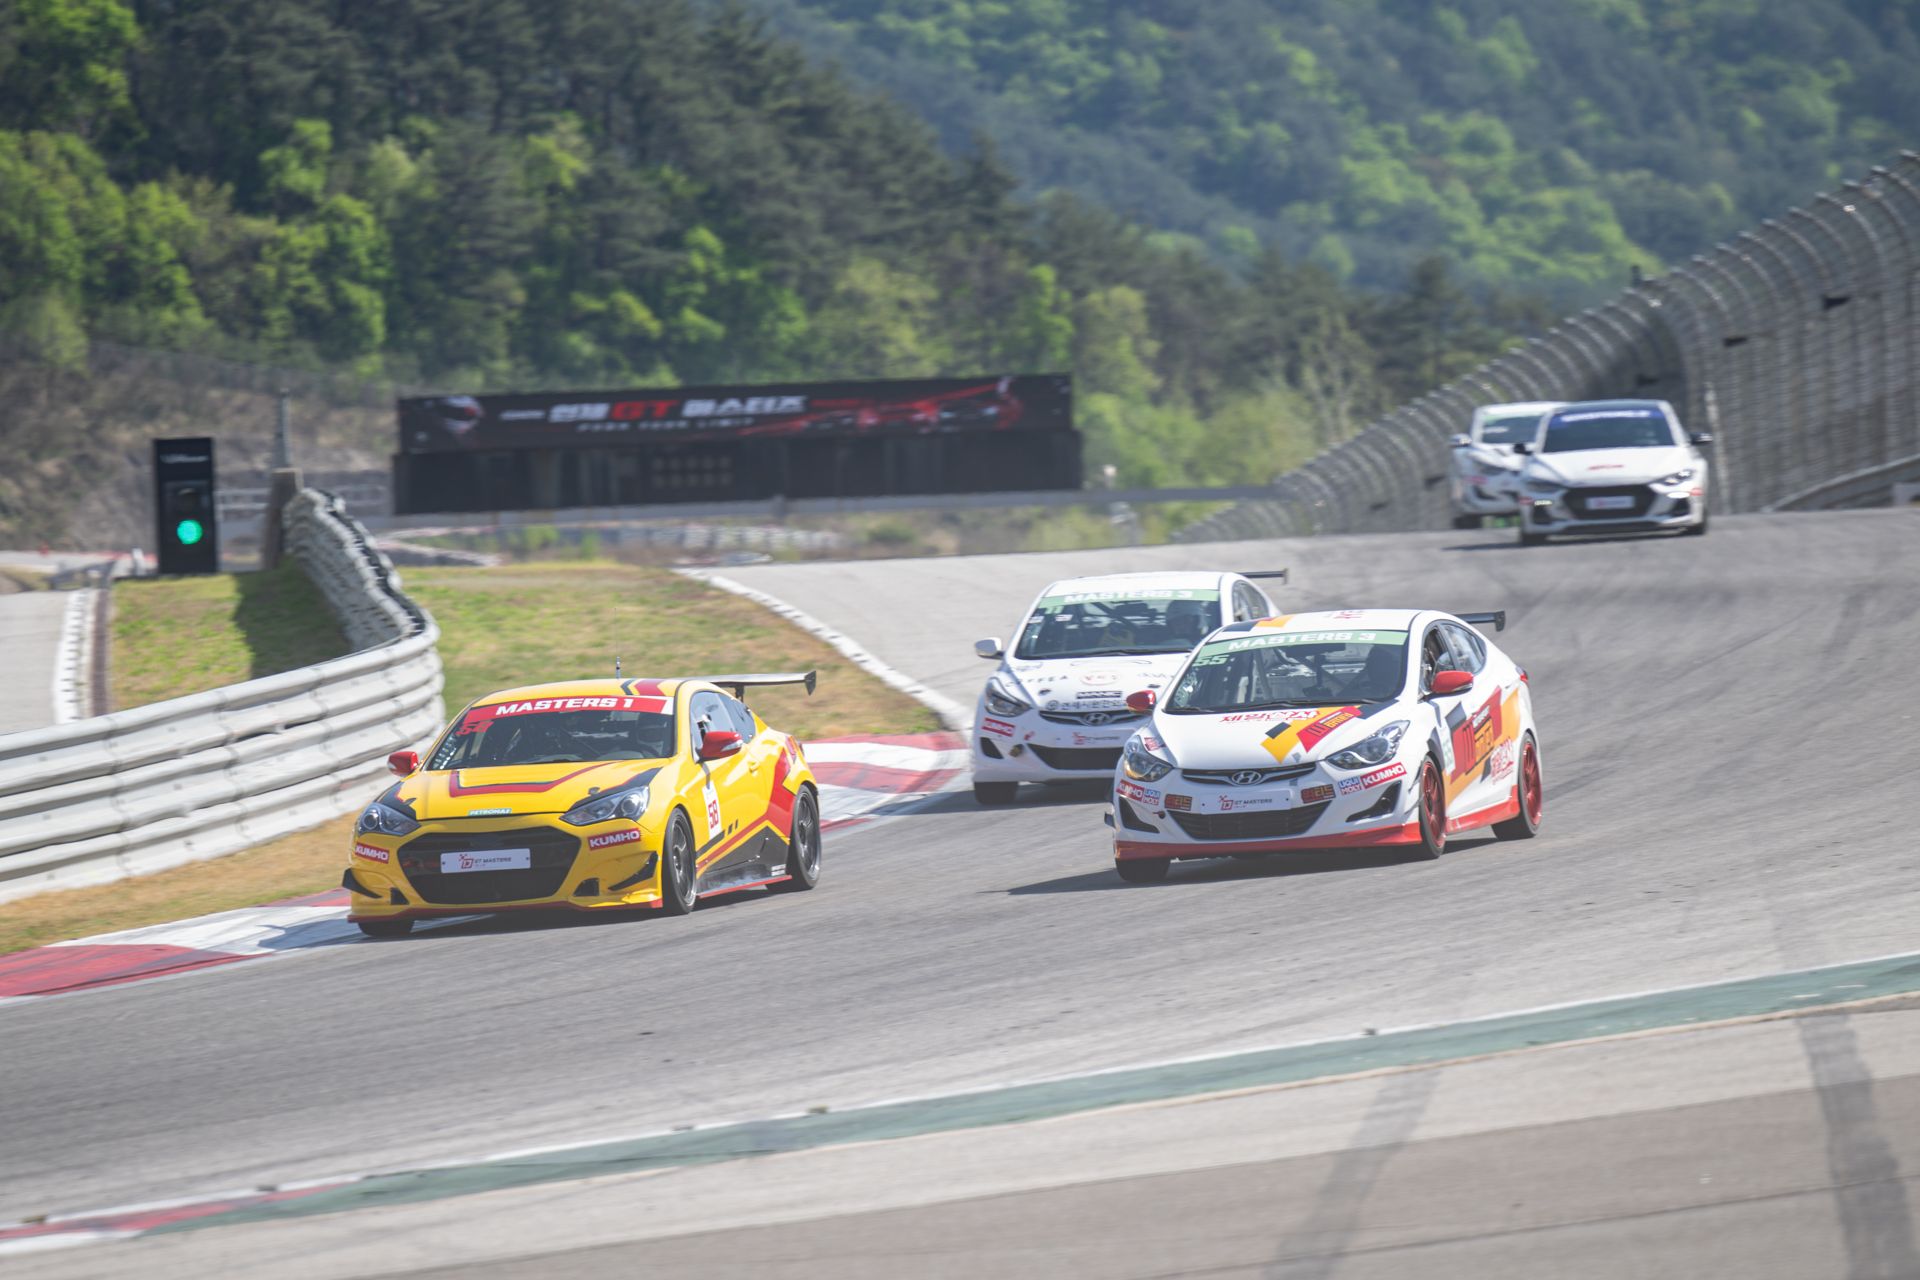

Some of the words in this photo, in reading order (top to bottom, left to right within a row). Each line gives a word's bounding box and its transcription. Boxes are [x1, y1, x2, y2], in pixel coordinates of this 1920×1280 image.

[1063, 590, 1173, 603] MASTERS
[1176, 590, 1193, 599] 3
[1228, 632, 1354, 652] MASTERS
[1357, 631, 1377, 643] 3
[1193, 655, 1230, 667] 55
[495, 697, 618, 716] MASTERS
[622, 697, 635, 709] 1
[455, 719, 494, 737] 58
[1338, 776, 1360, 788] LIQUI
[1362, 764, 1405, 785] KUMHO
[1119, 781, 1143, 798] KUMHO
[1341, 784, 1361, 796] MOLY
[707, 799, 720, 830] 58
[590, 830, 640, 848] KUMHO
[355, 844, 389, 862] KUMHO
[485, 856, 512, 864] MASTERS
